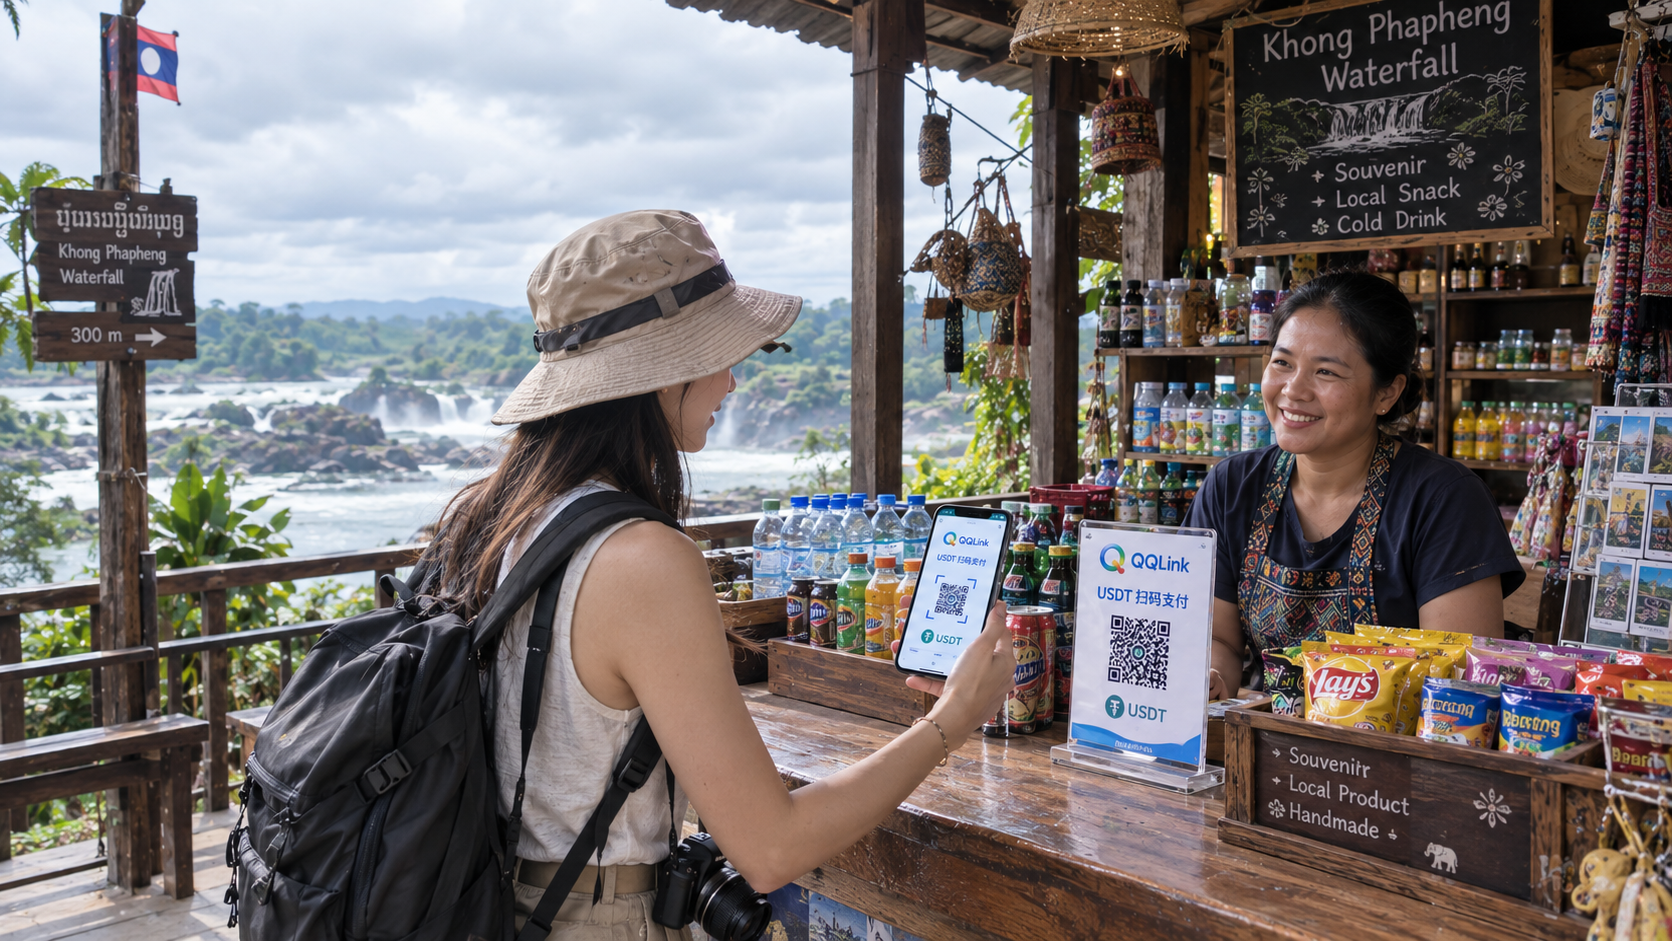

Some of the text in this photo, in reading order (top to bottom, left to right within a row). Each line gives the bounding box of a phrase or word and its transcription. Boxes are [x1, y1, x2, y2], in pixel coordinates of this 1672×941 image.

[1263, 0, 1510, 62] Khong Phapheng
[1321, 42, 1459, 92] Waterfall
[1335, 156, 1426, 182] Souvenir
[1336, 177, 1461, 208] Local Snack
[1337, 207, 1447, 234] Cold Drink
[58, 242, 166, 265] Khong Phapheng
[59, 268, 124, 285] Waterfall
[71, 327, 122, 343] 300 m
[959, 536, 989, 547] QQLink
[936, 553, 957, 563] USDT
[1131, 552, 1190, 573] QQLink
[1097, 586, 1189, 609] USDT 扫码支付
[936, 634, 963, 645] USDT
[1313, 669, 1375, 700] Lay's
[1128, 703, 1167, 722] USDT
[1289, 774, 1410, 816] Local Product
[1289, 802, 1379, 839] Handmade
